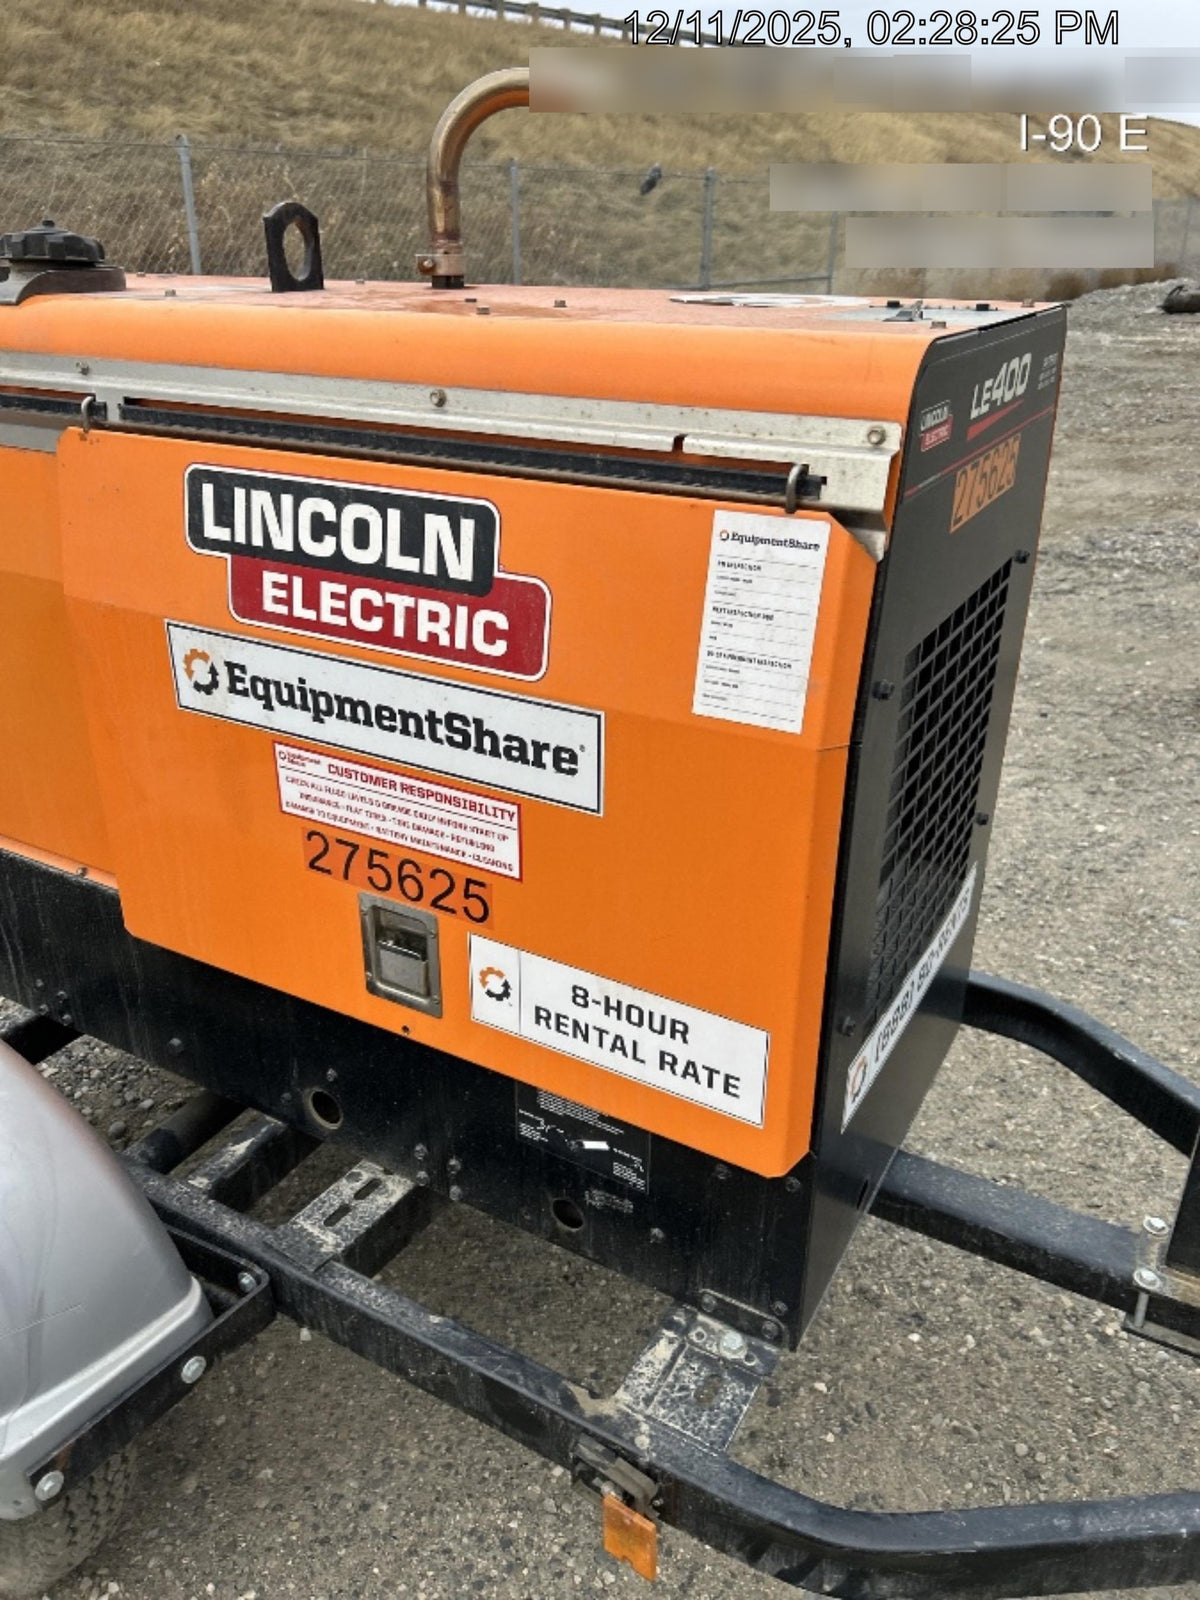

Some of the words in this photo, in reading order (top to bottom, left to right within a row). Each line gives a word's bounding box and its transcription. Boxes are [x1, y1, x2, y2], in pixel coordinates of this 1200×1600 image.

[970, 353, 1032, 420] LE400
[201, 482, 475, 583] LINCOLN
[730, 532, 820, 551] EquipmentShare
[261, 569, 510, 658] ELECTRIC
[224, 660, 578, 777] EquipmentShare
[328, 763, 397, 792] CUSTOMER
[400, 782, 516, 822] RESPONSIBILITY
[306, 830, 490, 923] 275625
[535, 1005, 646, 1065] RENTAL
[658, 1049, 741, 1099] RATE
[571, 984, 689, 1044] 8-HOUR
